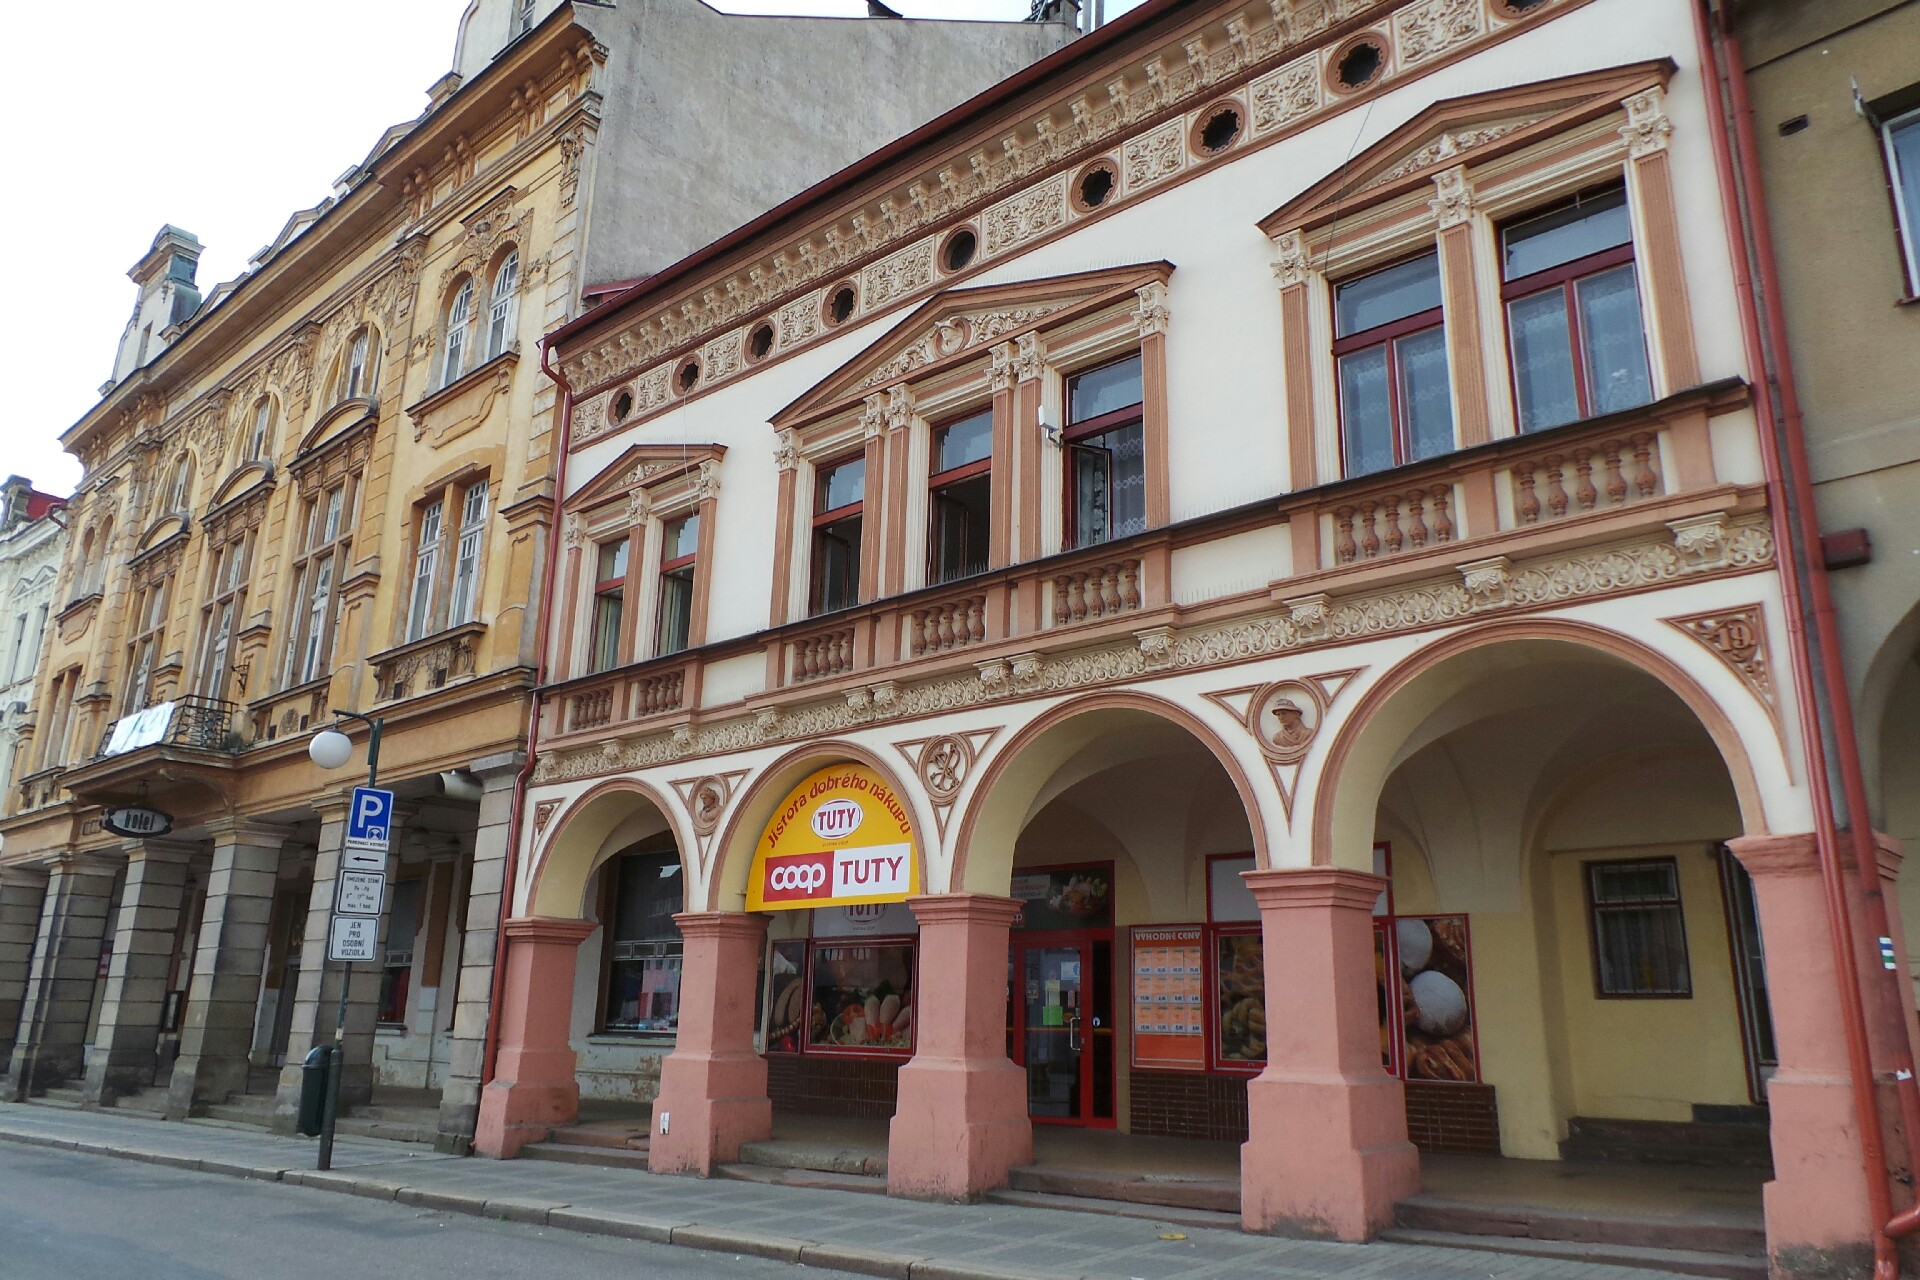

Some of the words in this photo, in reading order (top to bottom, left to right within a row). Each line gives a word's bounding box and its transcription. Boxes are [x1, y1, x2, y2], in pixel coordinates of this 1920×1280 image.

[357, 794, 383, 829] P
[768, 794, 808, 849] Jistota
[809, 773, 868, 799] dobrého
[869, 782, 911, 835] nákupu
[124, 810, 155, 831] hotel
[817, 807, 857, 831] TUTY
[770, 862, 826, 894] coop
[839, 856, 904, 885] TUTY
[350, 921, 362, 929] JEN
[348, 930, 361, 938] PRO
[1177, 931, 1201, 940] CENY
[342, 939, 365, 948] OSOBNÍ
[340, 949, 366, 957] VOZIDLA
